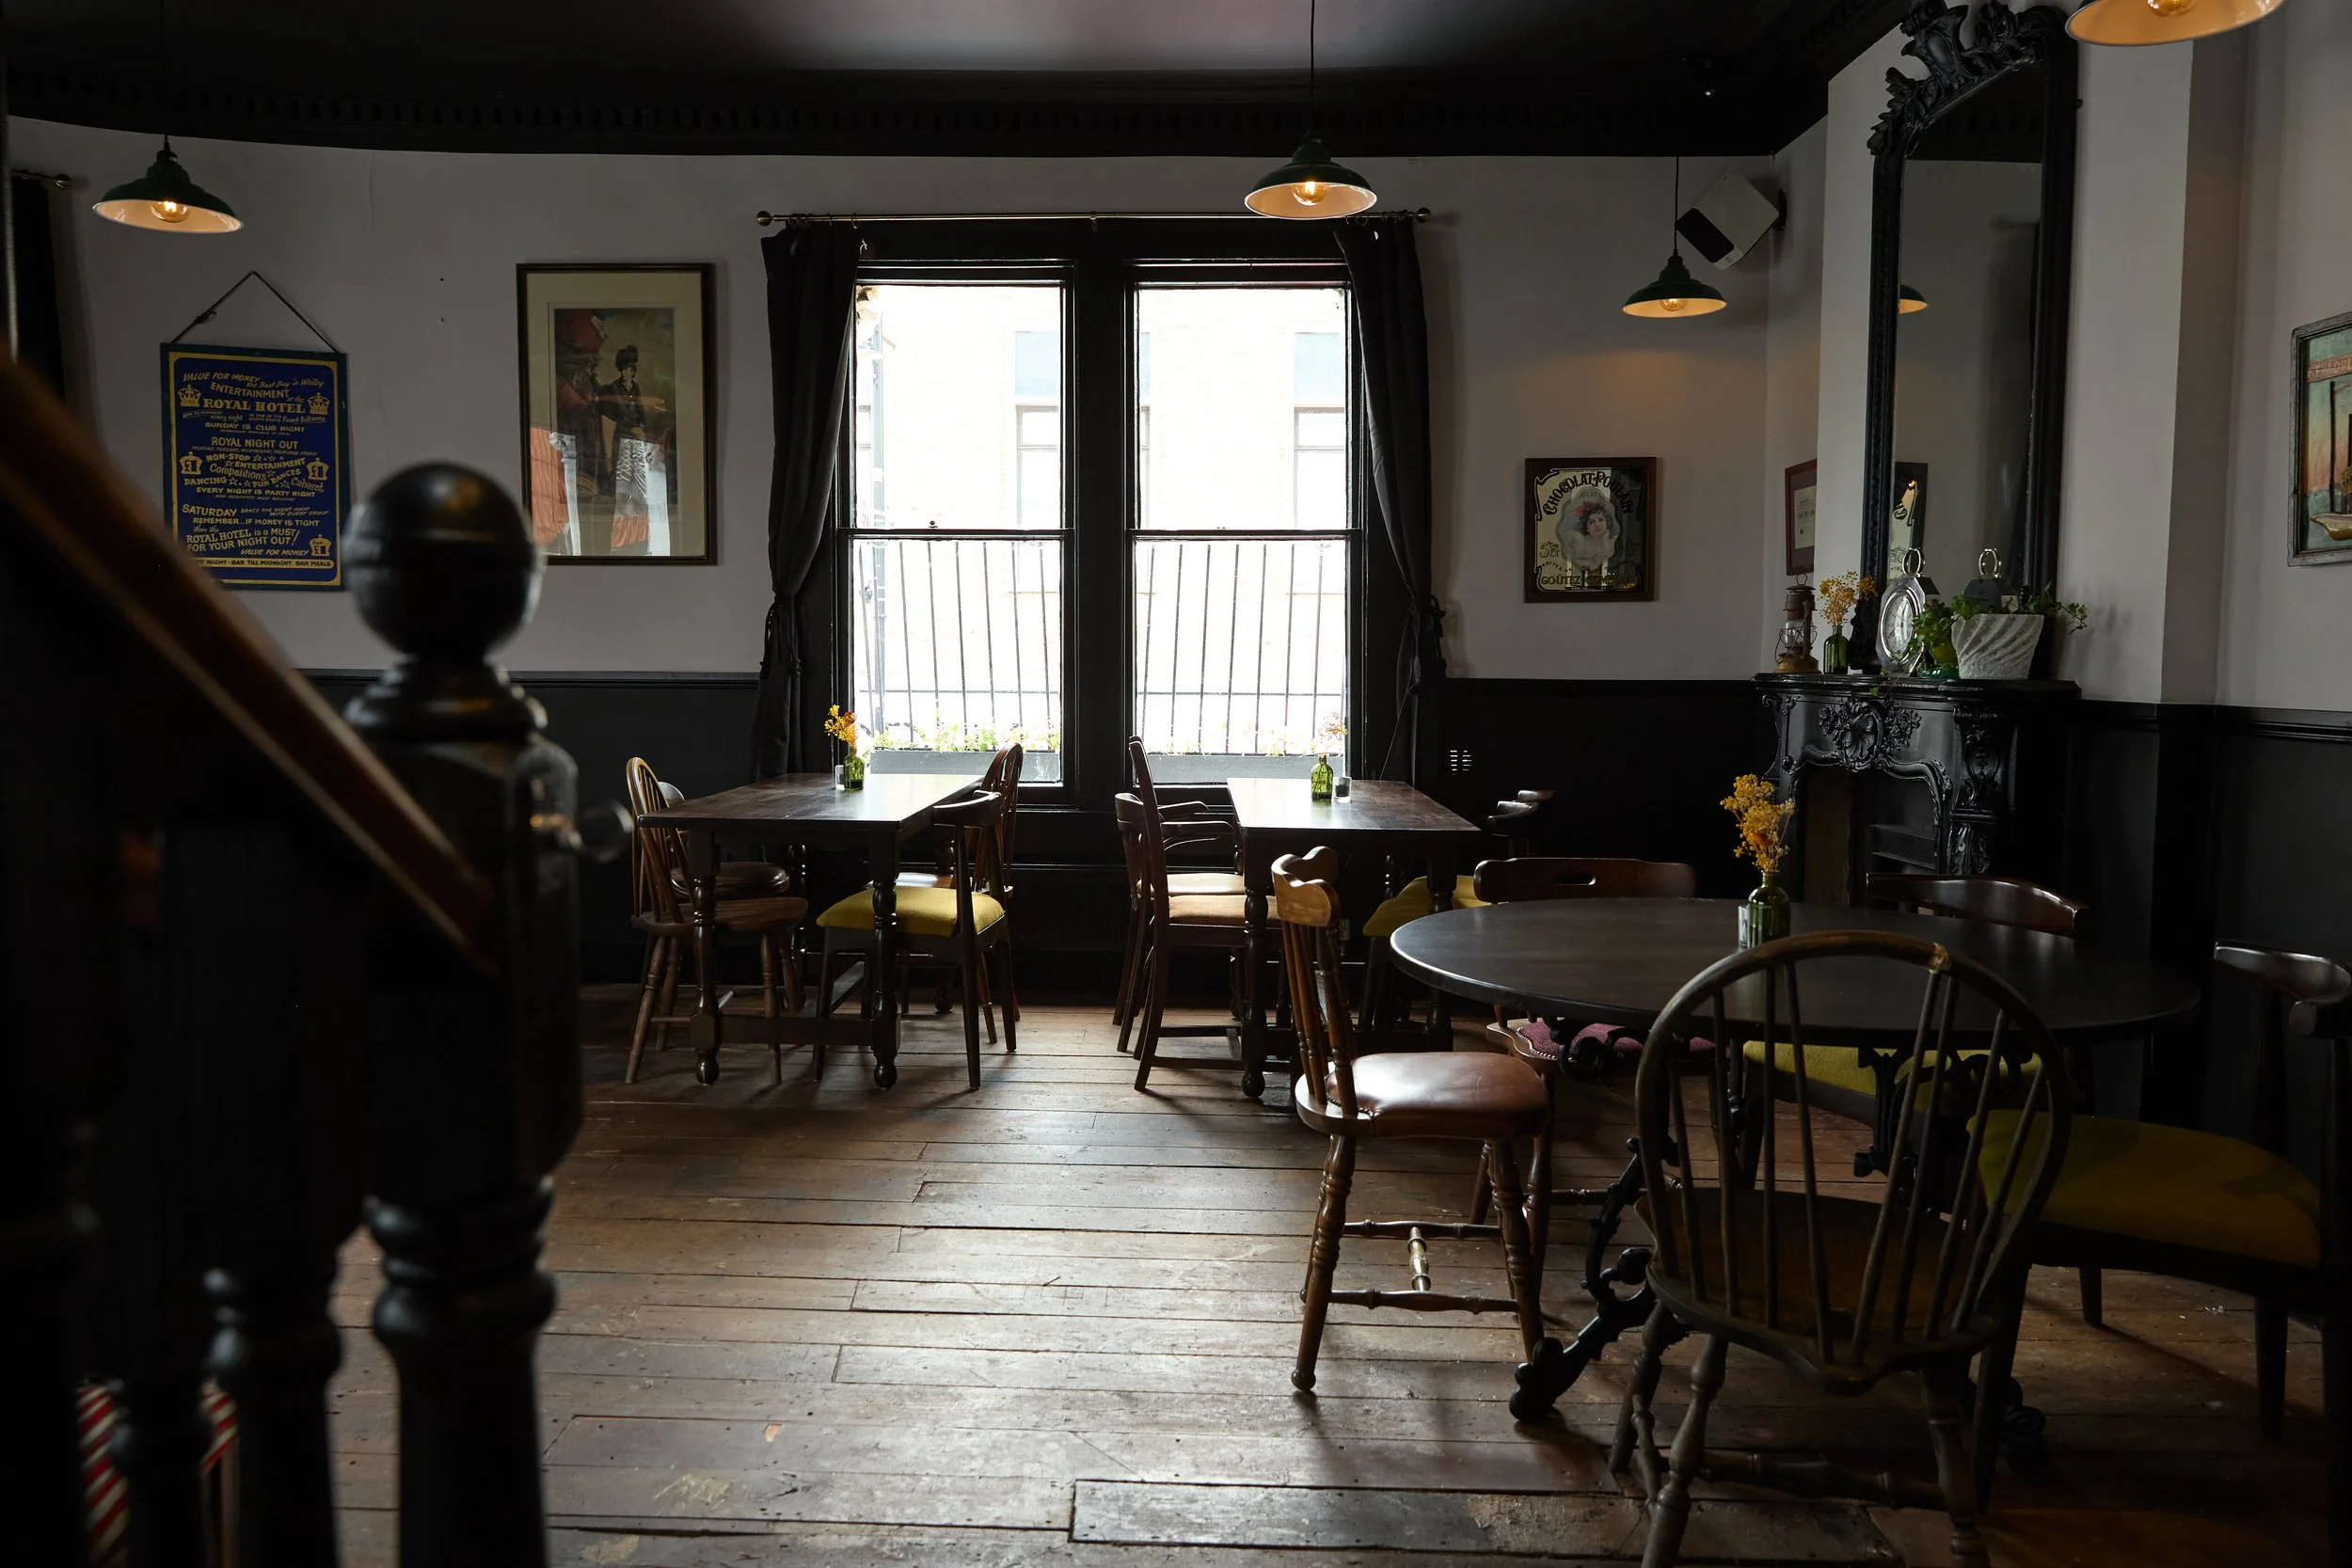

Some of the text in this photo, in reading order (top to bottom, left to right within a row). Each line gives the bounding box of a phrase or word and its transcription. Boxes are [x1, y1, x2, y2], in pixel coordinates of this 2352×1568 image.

[183, 372, 211, 382] VALUE
[230, 373, 262, 382] MONEY
[211, 382, 290, 399] ENTERTAINMENT
[203, 398, 306, 414] ROYAL HOTEL
[211, 436, 299, 449] ROYAL NIGHT OUT
[205, 453, 250, 462] NON-STOP
[234, 457, 306, 470] ENTERTAINMENT
[210, 463, 267, 481] Competitions
[270, 468, 302, 483] DANCES
[183, 476, 227, 486] DANCING
[291, 477, 325, 493] Cabaret
[1542, 473, 1595, 515] CHOCOLAT
[182, 504, 238, 517] SATURDAY
[186, 533, 217, 544] ROYAL
[219, 529, 252, 541] HOTEL
[187, 541, 207, 552] FOR
[208, 541, 235, 550] YOUR
[237, 537, 268, 547] NIGHT
[1540, 574, 1581, 585] GOÛTEZ
